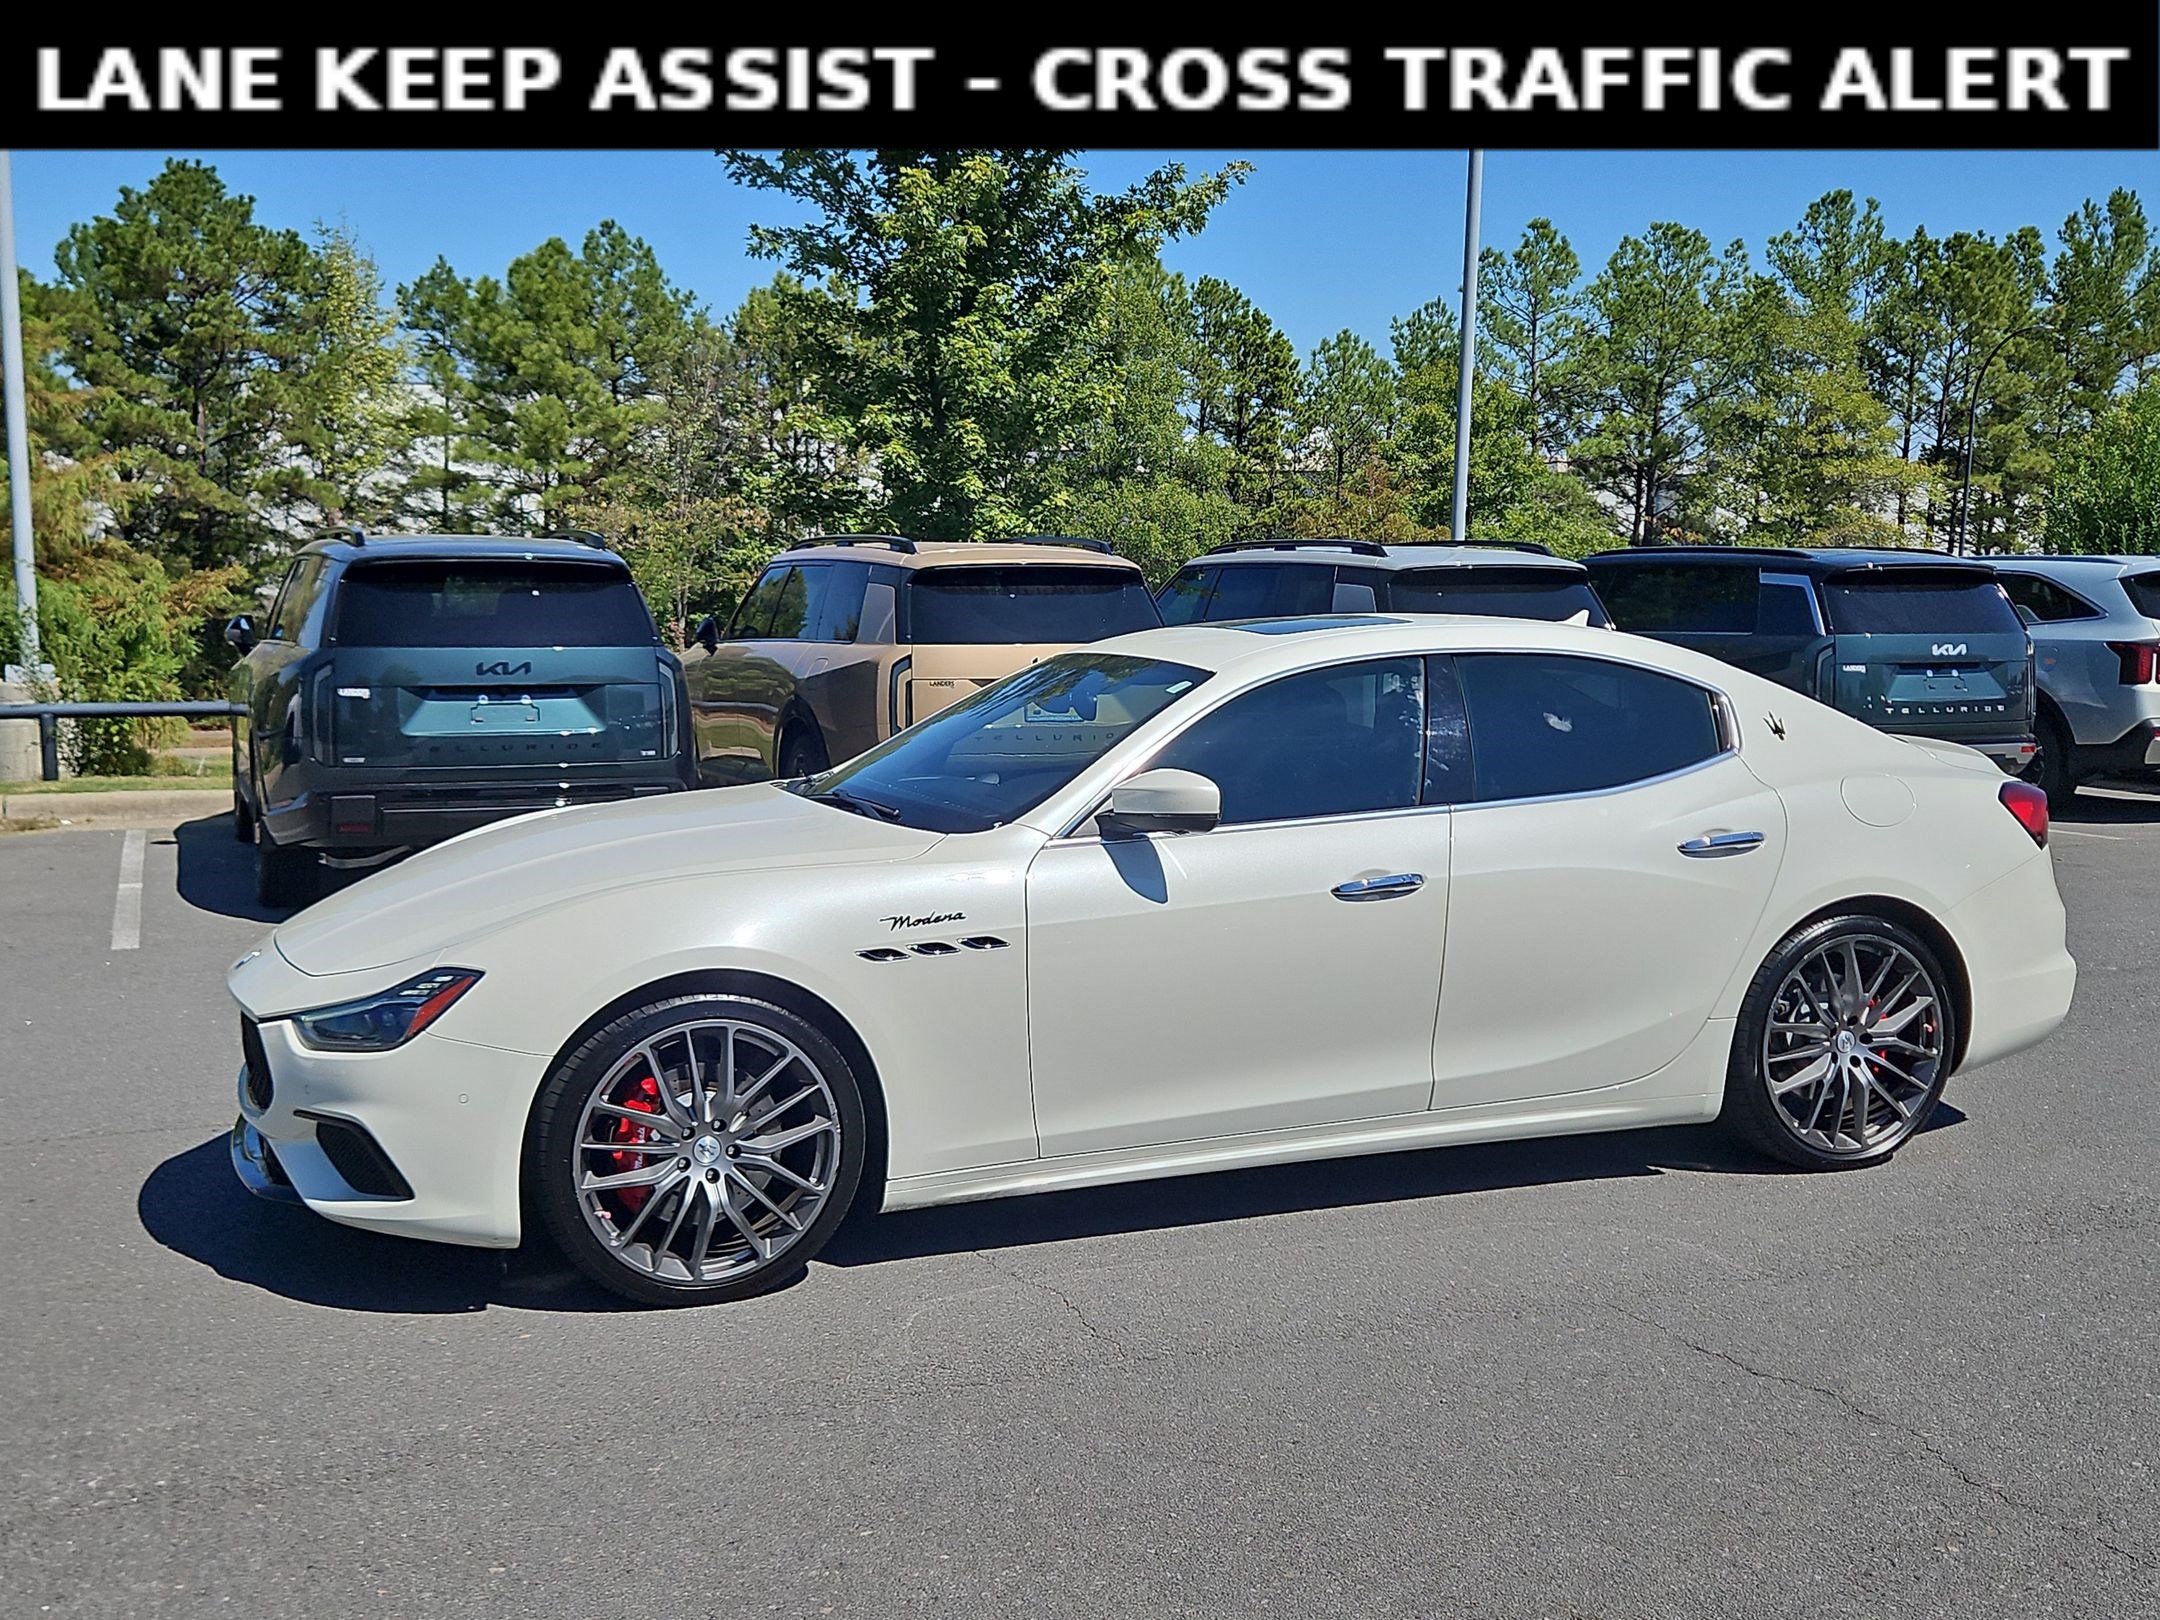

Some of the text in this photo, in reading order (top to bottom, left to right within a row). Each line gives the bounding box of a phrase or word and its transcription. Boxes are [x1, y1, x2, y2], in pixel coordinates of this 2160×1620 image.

[1931, 643, 1968, 656] KIA
[475, 661, 532, 676] KIA
[1885, 704, 2005, 715] TELLURIDE
[879, 910, 967, 932] Modena
